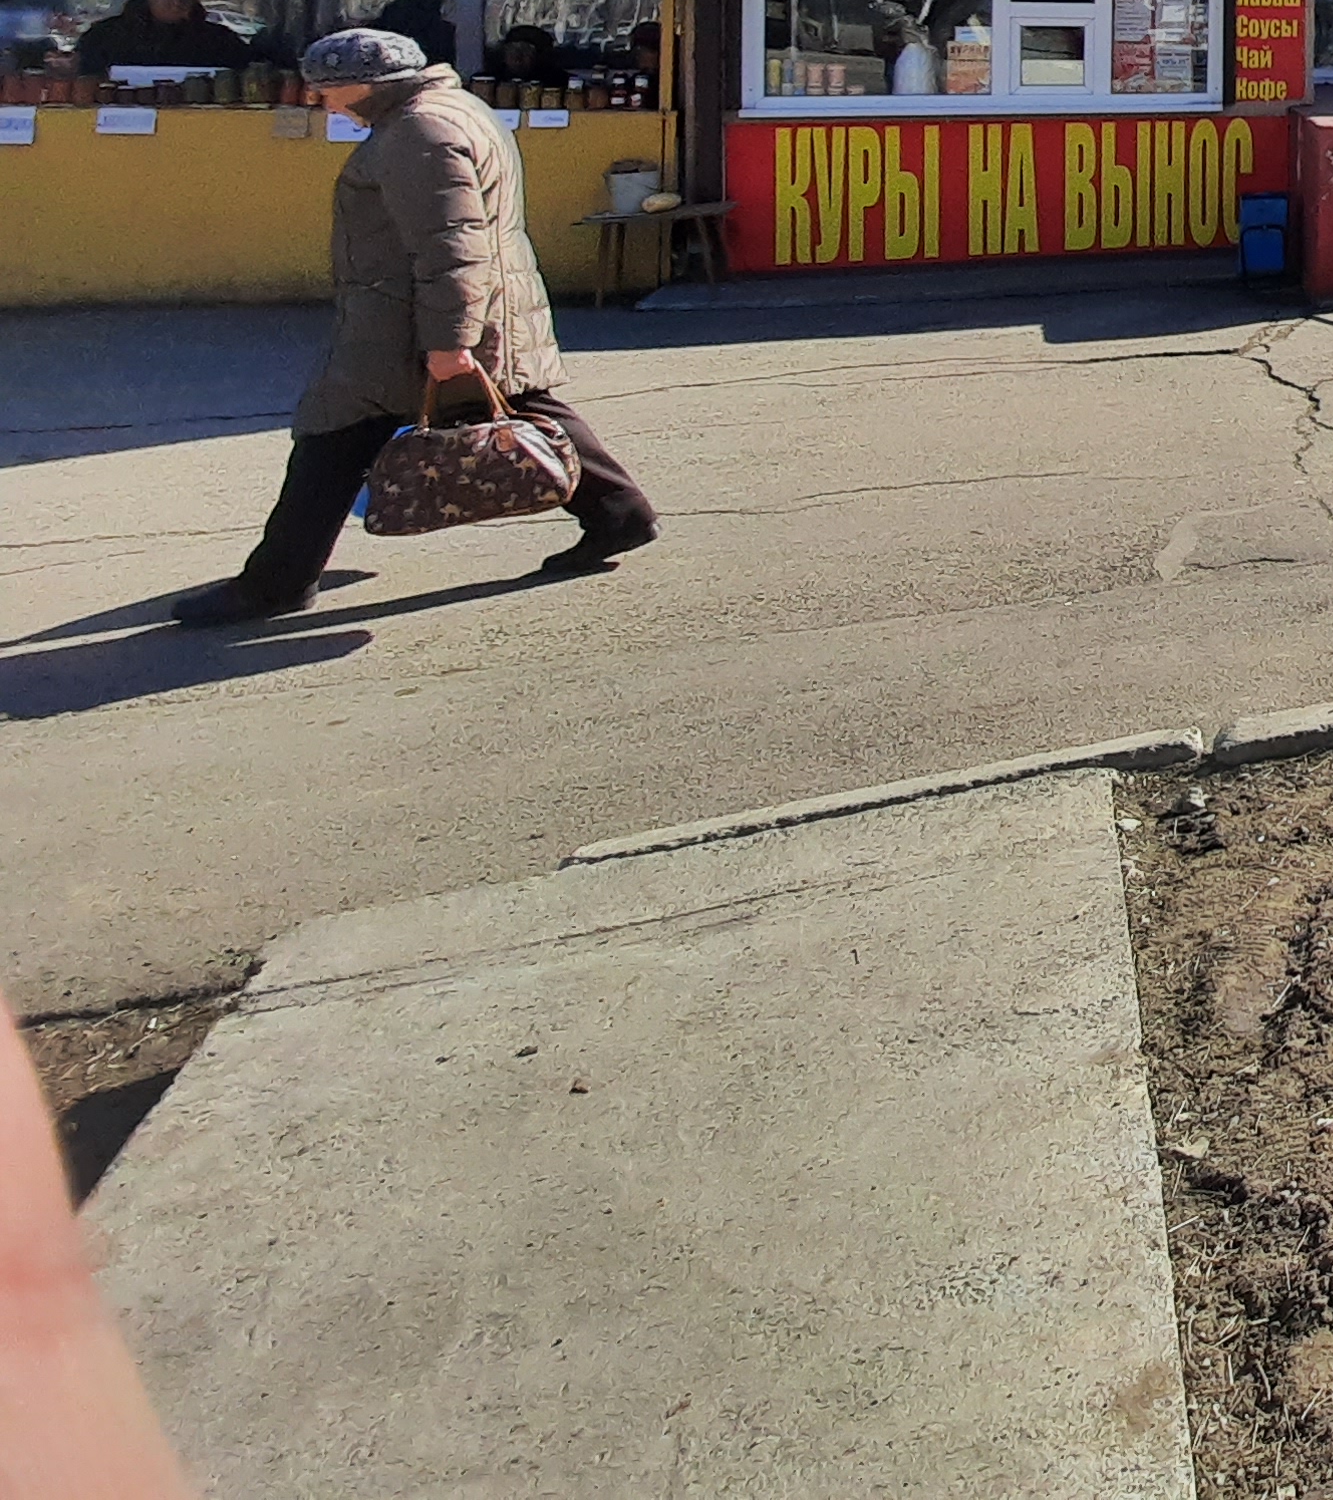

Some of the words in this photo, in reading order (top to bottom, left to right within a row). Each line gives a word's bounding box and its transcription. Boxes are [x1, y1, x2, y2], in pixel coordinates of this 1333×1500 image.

[1236, 14, 1298, 39] Соусы
[1236, 45, 1272, 69] Чай
[1236, 77, 1287, 102] Кофе
[775, 124, 939, 266] КУРЫ
[968, 122, 1039, 257] НА
[1064, 118, 1253, 252] ВЫНОС
